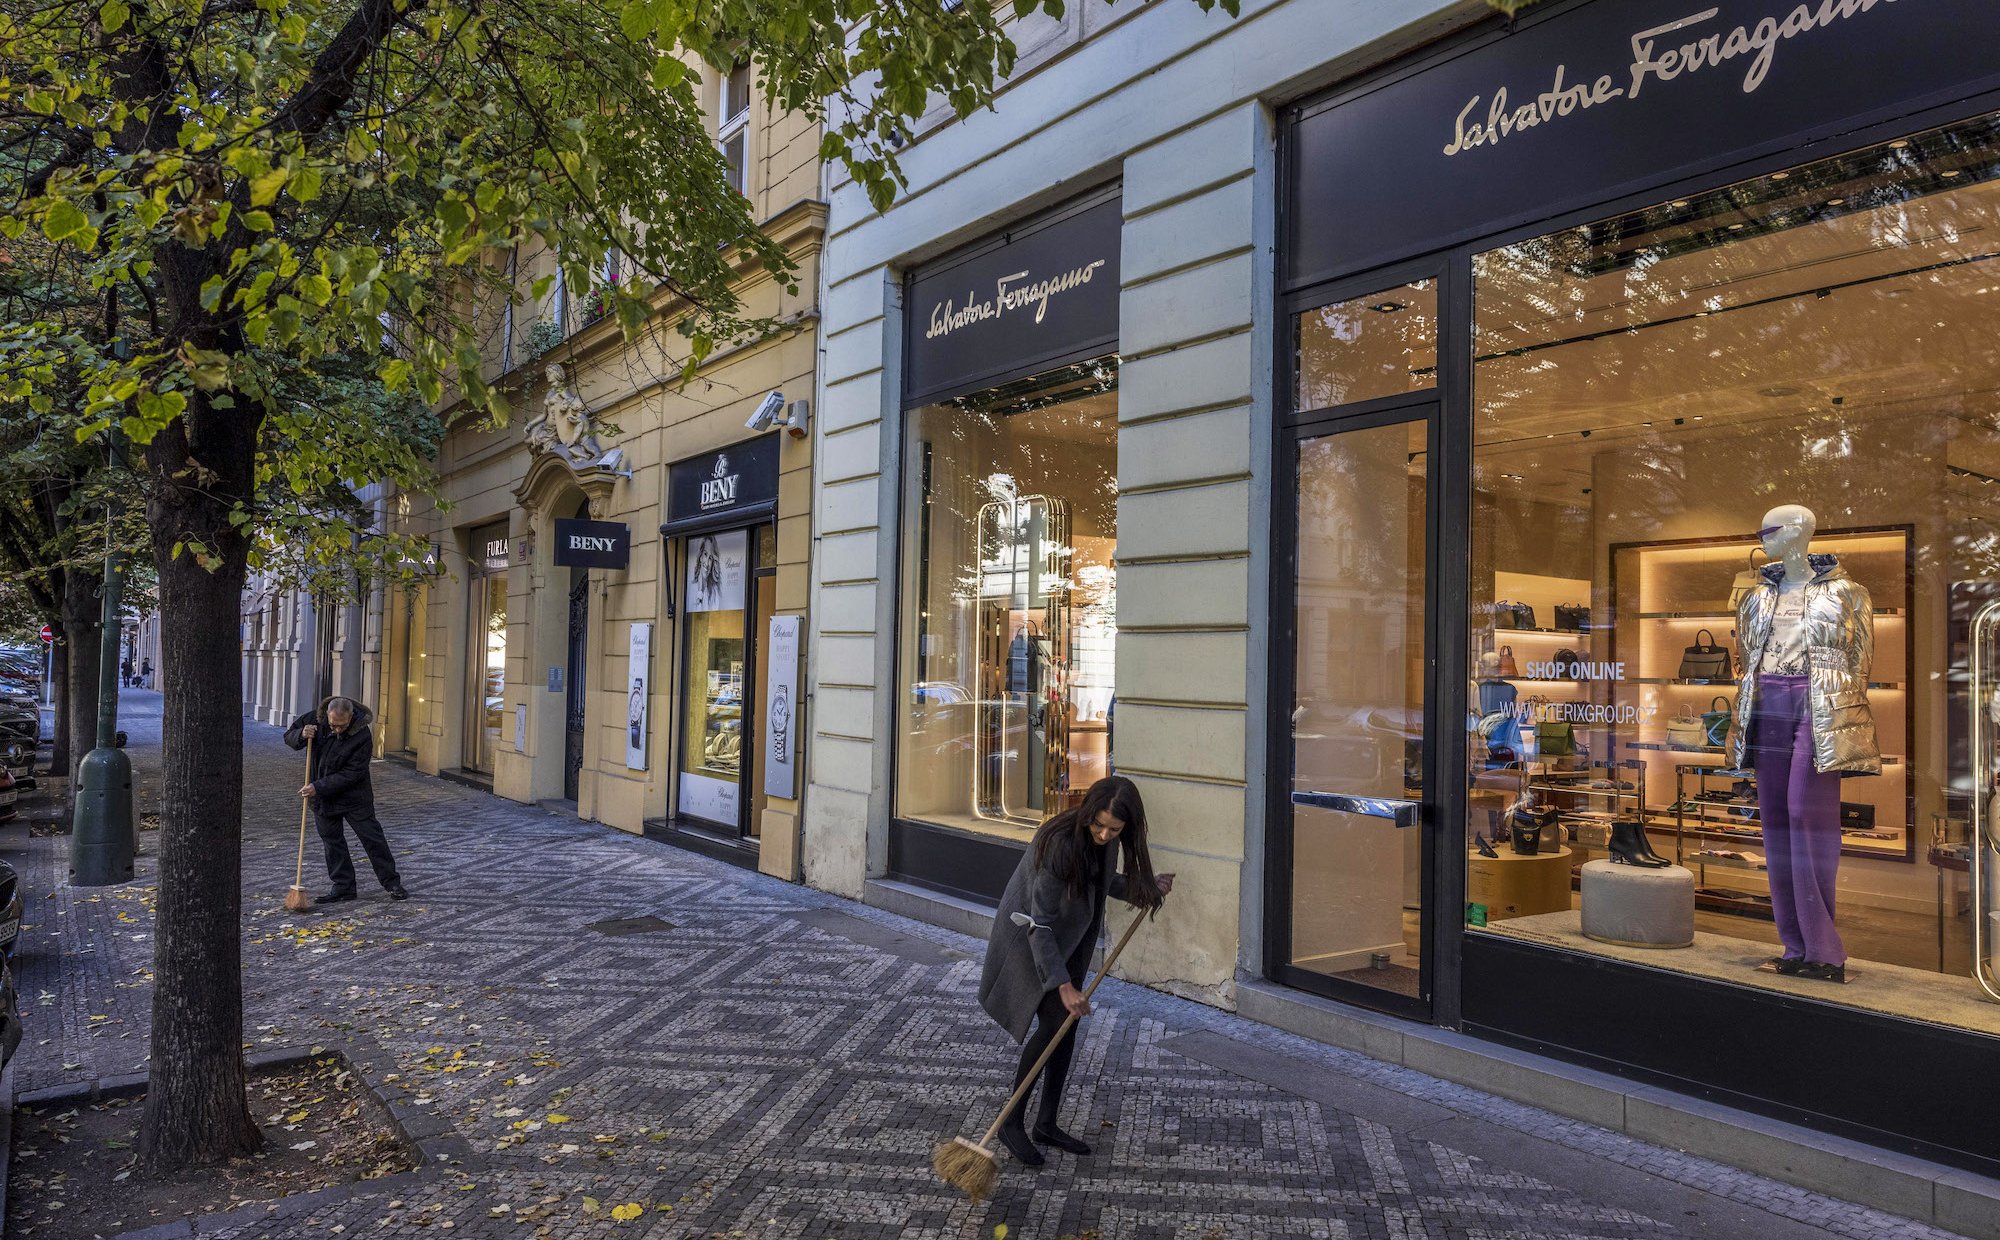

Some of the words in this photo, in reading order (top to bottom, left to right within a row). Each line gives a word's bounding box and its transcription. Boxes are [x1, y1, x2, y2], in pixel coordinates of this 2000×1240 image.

[1442, 63, 1623, 156] Salvatore
[1627, 0, 1898, 98] Ferragam
[925, 290, 995, 339] Salvatore
[996, 258, 1105, 325] Ferragamo
[700, 474, 740, 506] BENY
[486, 538, 509, 557] FURLA
[568, 535, 617, 552] BENY
[1526, 661, 1565, 680] SHOP
[1569, 661, 1625, 681] ONLINE
[1500, 701, 1655, 726] WWW.LITERIXGROUP.CZ
